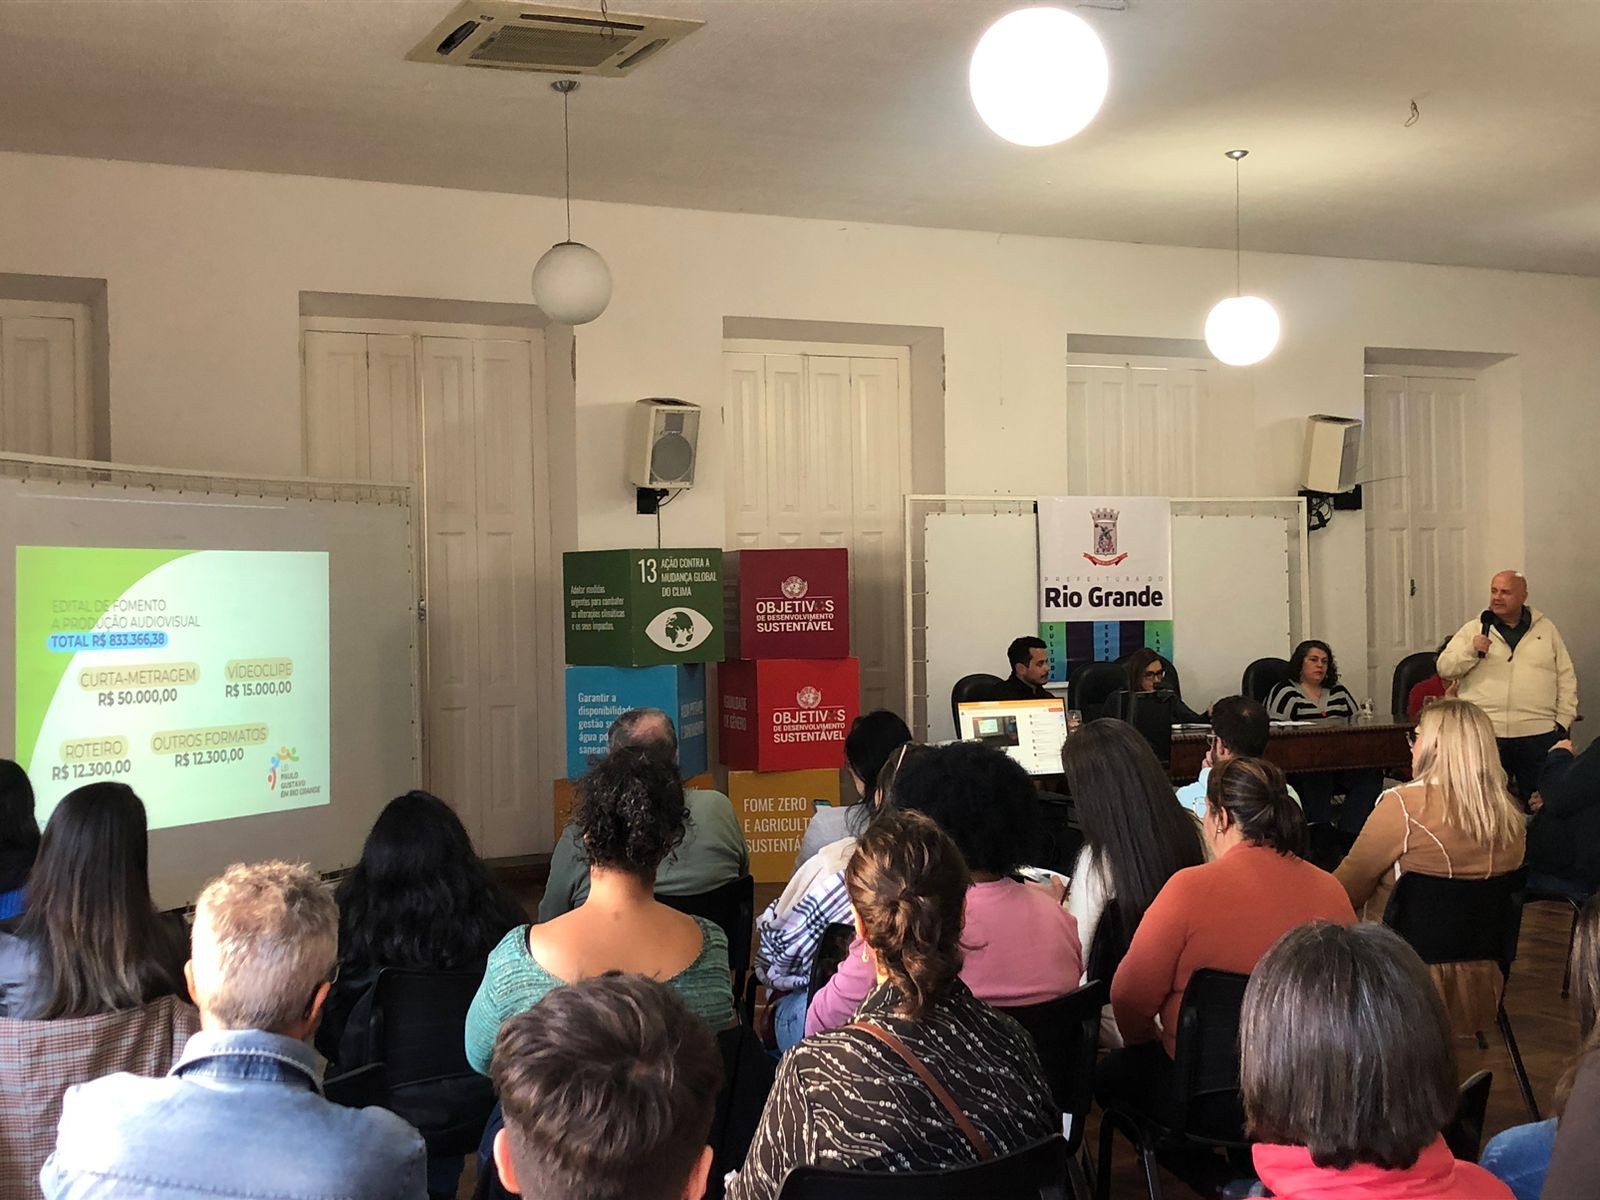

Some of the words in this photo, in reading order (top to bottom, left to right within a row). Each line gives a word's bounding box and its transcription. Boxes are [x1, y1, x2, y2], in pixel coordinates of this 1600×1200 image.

[638, 558, 657, 584] 13
[661, 556, 678, 570] AÇÃO
[680, 558, 704, 568] CONTRA
[705, 558, 710, 568] A
[662, 572, 692, 584] MUDANÇA
[694, 572, 718, 582] GLOBAL
[662, 588, 671, 597] DO
[672, 587, 692, 596] CLIMA
[1045, 585, 1082, 608] Rio
[1088, 585, 1163, 608] Grande
[52, 600, 92, 613] EDITAL
[94, 599, 110, 612] DE
[114, 599, 166, 612] FOMENTO
[63, 615, 128, 630] PRODUÇÃO
[130, 616, 200, 628] AUDIOVISUAL
[767, 613, 834, 621] DESENVOLVIMENTO
[757, 618, 834, 632] SUSTENTÁVEL
[51, 635, 89, 648] TOTAL
[92, 633, 106, 648] R$
[110, 633, 165, 647] 833.366,38
[80, 668, 196, 687] CURTA-METRAGEM
[227, 663, 292, 678] VÍDEOCLIPE
[98, 691, 114, 706] R$
[118, 688, 177, 705] 50.000,00
[225, 684, 239, 698] R$
[242, 681, 292, 696] 15.000,00
[578, 692, 609, 702] Garantir
[578, 719, 604, 730] gestão
[783, 722, 845, 731] DESENVOLVIMENTO
[153, 733, 201, 751] OUTROS
[206, 728, 267, 746] FORMATOS
[579, 732, 597, 743] água
[774, 729, 845, 743] SUSTENTÁVEL
[65, 740, 122, 758] ROTEIRO
[175, 752, 190, 767] R$
[192, 748, 244, 766] 12.300,00
[52, 764, 69, 780] R$
[73, 759, 131, 778] 12.300,00
[744, 798, 774, 812] FOME
[778, 797, 807, 812] ZERO
[744, 819, 750, 832] E
[754, 818, 811, 832] AGRICULT
[746, 835, 802, 853] SUSTENTÁ
